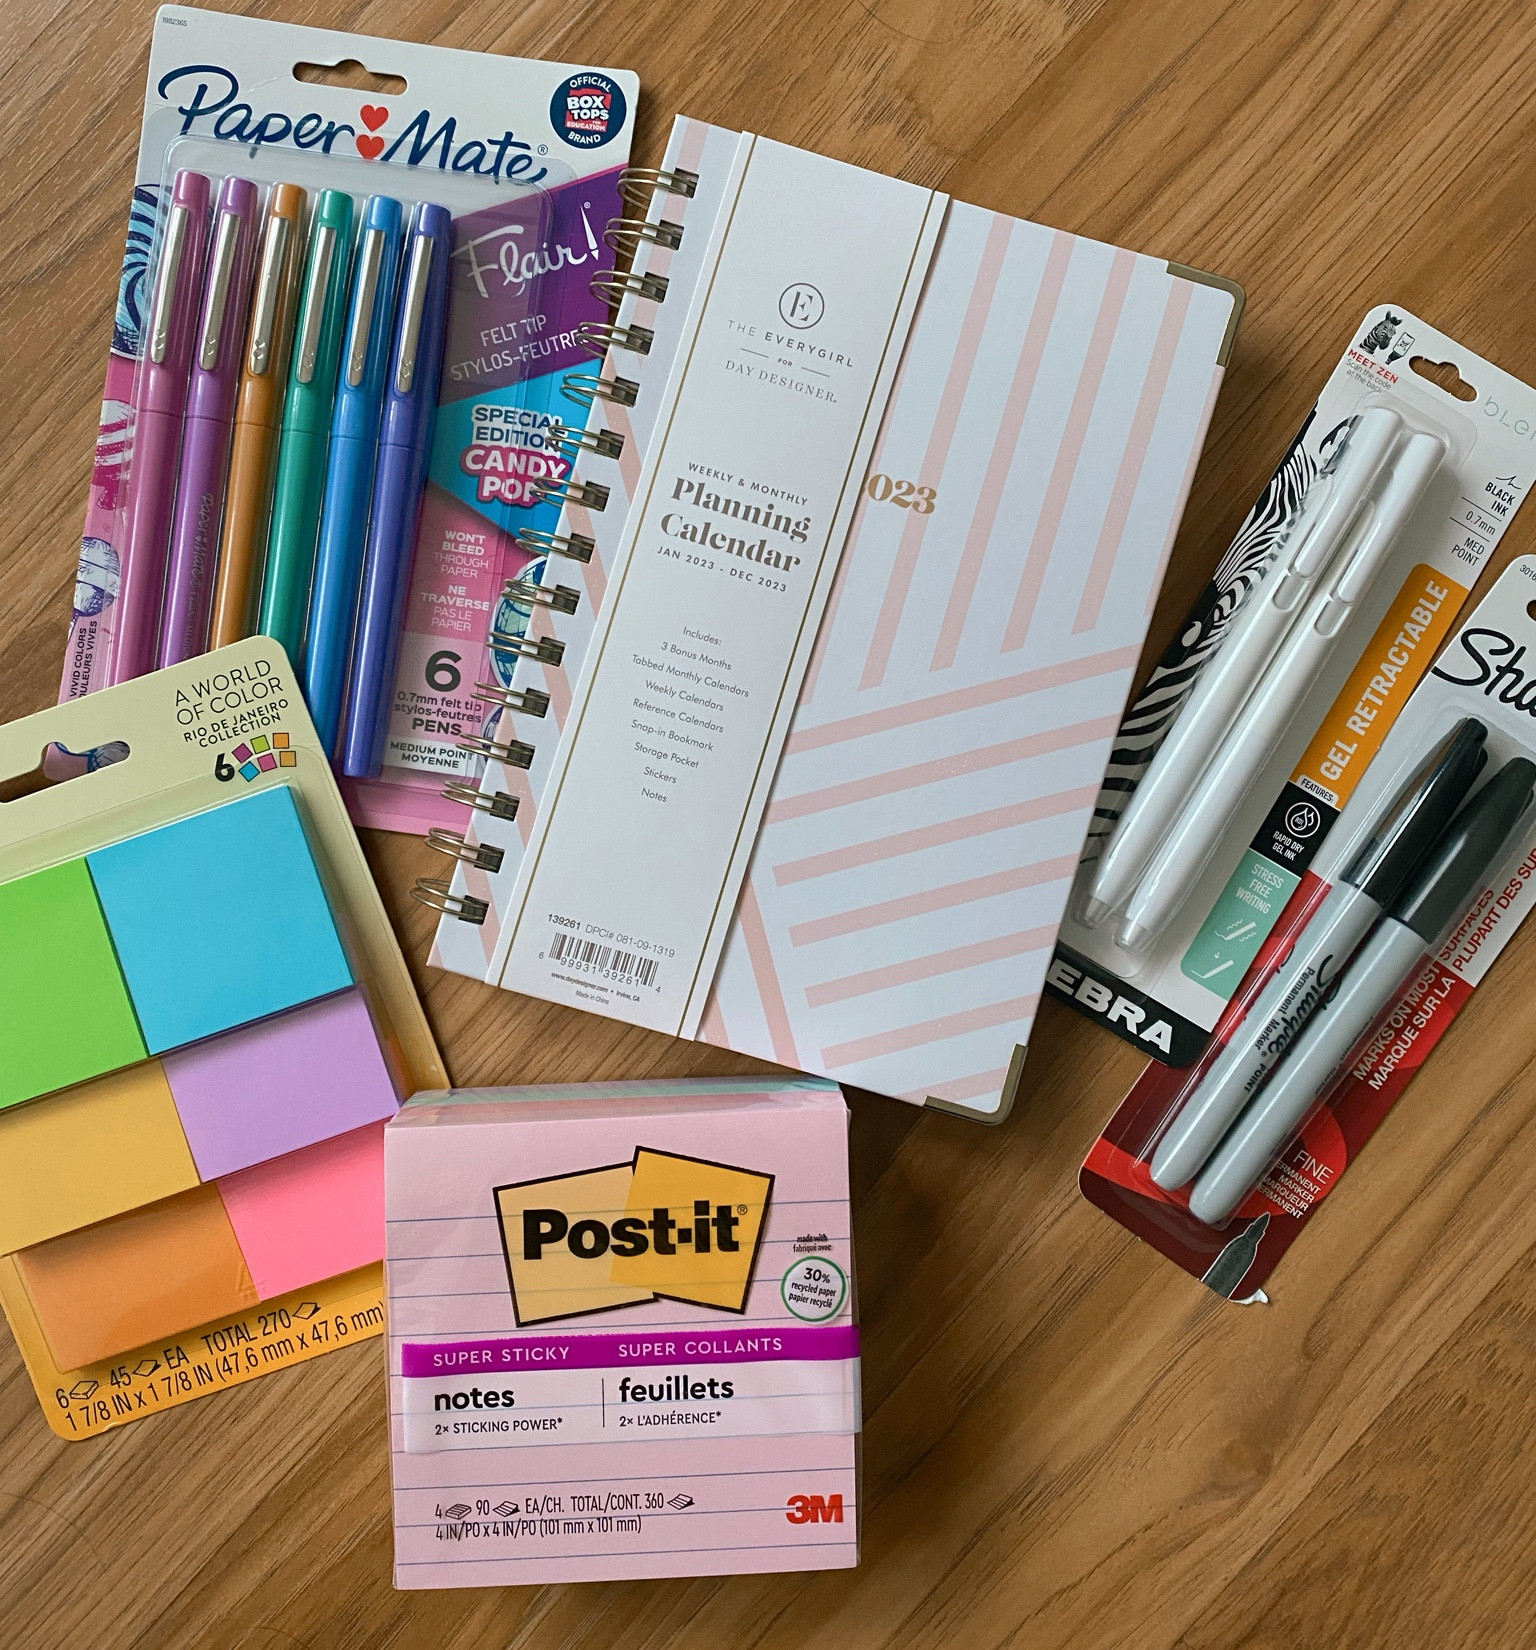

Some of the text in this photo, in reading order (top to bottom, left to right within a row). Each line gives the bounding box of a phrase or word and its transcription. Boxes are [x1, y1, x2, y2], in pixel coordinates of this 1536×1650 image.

[570, 76, 611, 92] OFFICIAL
[567, 96, 605, 110] BOX
[571, 109, 609, 120] TOPS
[158, 65, 547, 183] Paper Mate
[566, 121, 605, 131] EDUCATION
[568, 131, 601, 144] BRAND
[480, 314, 547, 347] FELT TIP
[728, 320, 853, 368] THE EVERYGIRL
[725, 360, 755, 376] DAY
[778, 358, 792, 366] FOR
[1346, 359, 1391, 390] Scan the code
[1348, 349, 1398, 384] MEET ZEN
[1355, 373, 1366, 384] the
[474, 407, 565, 435] SPECIAL
[465, 449, 566, 479] CANDY
[688, 462, 808, 506] WEEKLY & MONTHLY
[864, 474, 937, 514] 023
[1485, 482, 1515, 506] BLACK
[670, 476, 811, 544] Planning
[1465, 510, 1496, 535] 0.7mm
[1491, 501, 1509, 517] INK
[442, 542, 485, 556] BLEED
[445, 530, 486, 544] WON'T
[661, 513, 801, 572] Calendar
[1464, 537, 1484, 555] MED
[434, 552, 489, 569] THROUGH
[657, 546, 787, 592] JAN 2023 DEC 2023
[1452, 545, 1479, 566] POINT
[440, 565, 478, 579] PAPER
[421, 592, 490, 611] TRAVERSE
[448, 585, 466, 596] NE
[431, 617, 471, 632] PAPIER
[434, 606, 473, 620] PAS LE
[86, 621, 98, 651] VIVES
[682, 626, 722, 646] Includes:
[70, 627, 87, 697] VIVID COLORS
[661, 641, 732, 671] 3 Bonus Months
[176, 660, 271, 707] A WORLD
[425, 650, 461, 692] 6
[632, 654, 749, 698] Tabbed Monthly Calendars
[1320, 580, 1448, 781] GEL RETRACTABLE
[177, 677, 283, 725] OF COLOR
[440, 697, 461, 709] felt
[645, 679, 724, 712] Weekly Calendars
[183, 699, 288, 742] RIO DE JANEIRO
[394, 703, 482, 723] stylos-feutres
[412, 717, 462, 736] PENS
[632, 698, 724, 733] Reference Calendars
[199, 712, 281, 747] COLLECTION
[631, 719, 714, 752] Snap-in Bookmark
[389, 741, 436, 755] MEDIUM
[402, 753, 459, 769] MOYENNE
[634, 741, 699, 769] Storage Pocket
[215, 753, 235, 782] 6
[643, 766, 677, 784] Stickers
[641, 788, 667, 803] Notes
[1301, 778, 1334, 803] FEATURES:
[1272, 831, 1304, 853] RAPID DRY
[1272, 842, 1296, 861] GEL INK
[1250, 880, 1273, 899] FREE
[1252, 864, 1285, 889] STRESS
[1235, 886, 1271, 914] WRITING
[548, 914, 675, 958] 139261 DPCI# 081-09-1319
[551, 972, 609, 993] www.daydesigner.com
[1279, 967, 1315, 1014] Permanent
[1368, 878, 1523, 1091] MARQUE SUR LA PLUPART DES
[1046, 958, 1173, 1054] EBRA
[1255, 1018, 1280, 1051] Marker
[1353, 1027, 1395, 1080] MARKS
[1391, 999, 1412, 1028] ON
[1244, 1063, 1267, 1092] POINT
[1293, 1149, 1334, 1185] FINE
[1279, 1174, 1315, 1204] MARKER
[523, 1200, 740, 1261] Post-it
[804, 1267, 831, 1284] 30%
[788, 1292, 832, 1308] papier recyclé
[791, 1282, 836, 1298] recycled paper
[56, 1308, 292, 1409] 6 45 EA TOTAL 270
[433, 1337, 783, 1368] SUPER STICKY SUPER COLLANTS
[80, 1316, 348, 1427] 7/8 IN 7/8 IN (47,6 mm 47,6
[434, 1375, 734, 1411] notes feuillets
[453, 1419, 510, 1434] STICKING
[476, 1492, 664, 1516] 90 EA/CH. TOTAL/CONT. 360
[786, 1494, 844, 1525] 3M
[446, 1514, 643, 1541] IN/PO IN/PO (101 mm 101 mm)
